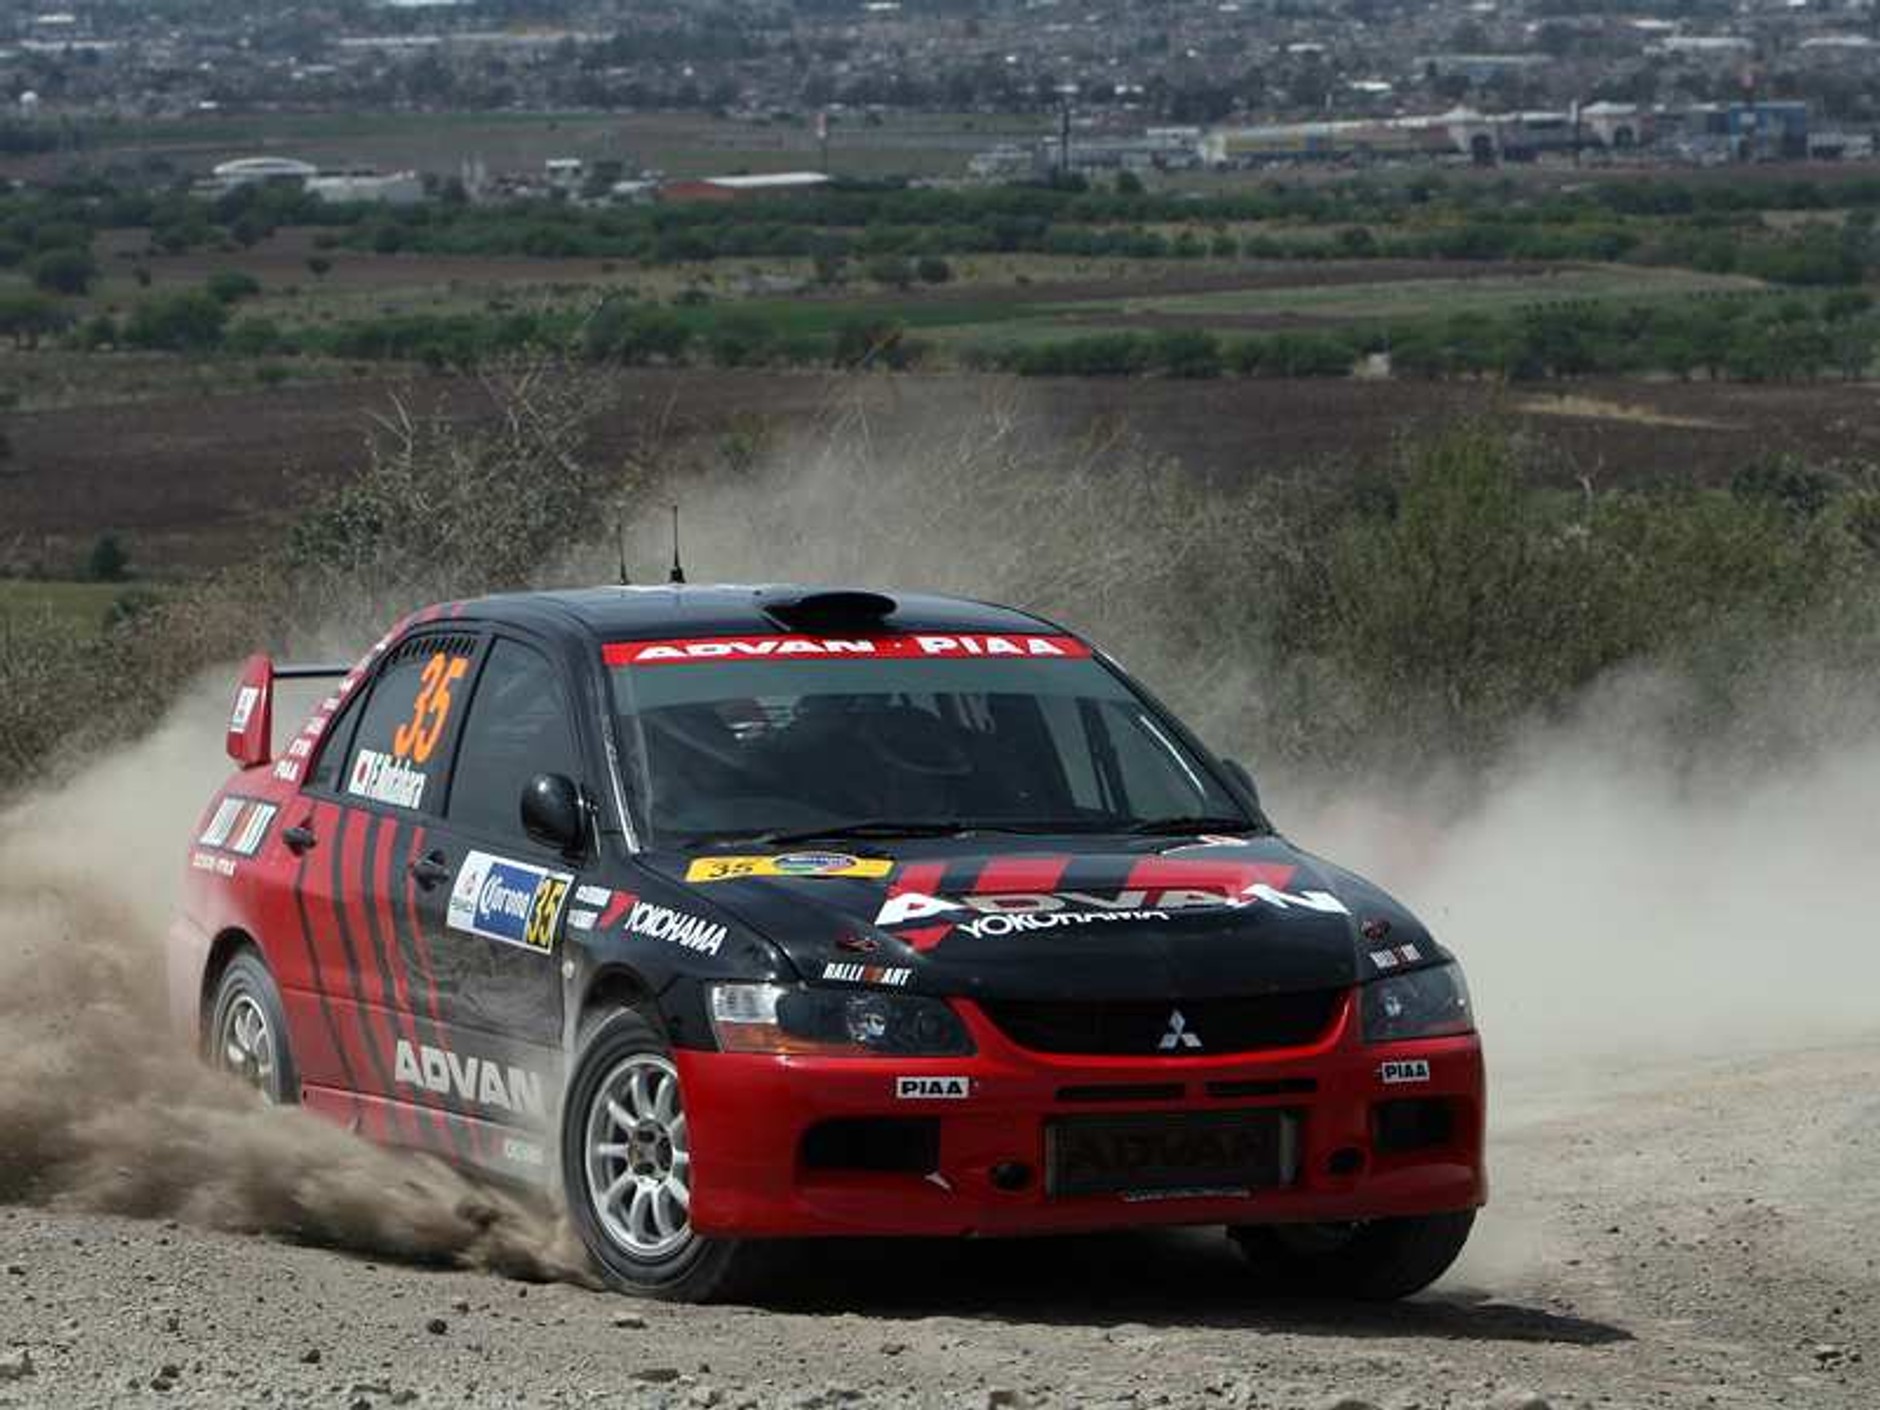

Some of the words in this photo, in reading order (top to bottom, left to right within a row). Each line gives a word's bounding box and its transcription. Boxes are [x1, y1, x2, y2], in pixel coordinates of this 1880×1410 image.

[634, 639, 875, 661] ADVAN
[914, 636, 1065, 656] PIAA
[392, 650, 469, 763] 35
[708, 862, 754, 878] 35
[528, 878, 567, 947] 35
[875, 883, 1352, 926] ADVAN
[624, 900, 728, 956] YOKOHAMA
[394, 1039, 544, 1116] ADVAN
[901, 1080, 963, 1095] PIAA
[1384, 1063, 1428, 1079] PIAA
